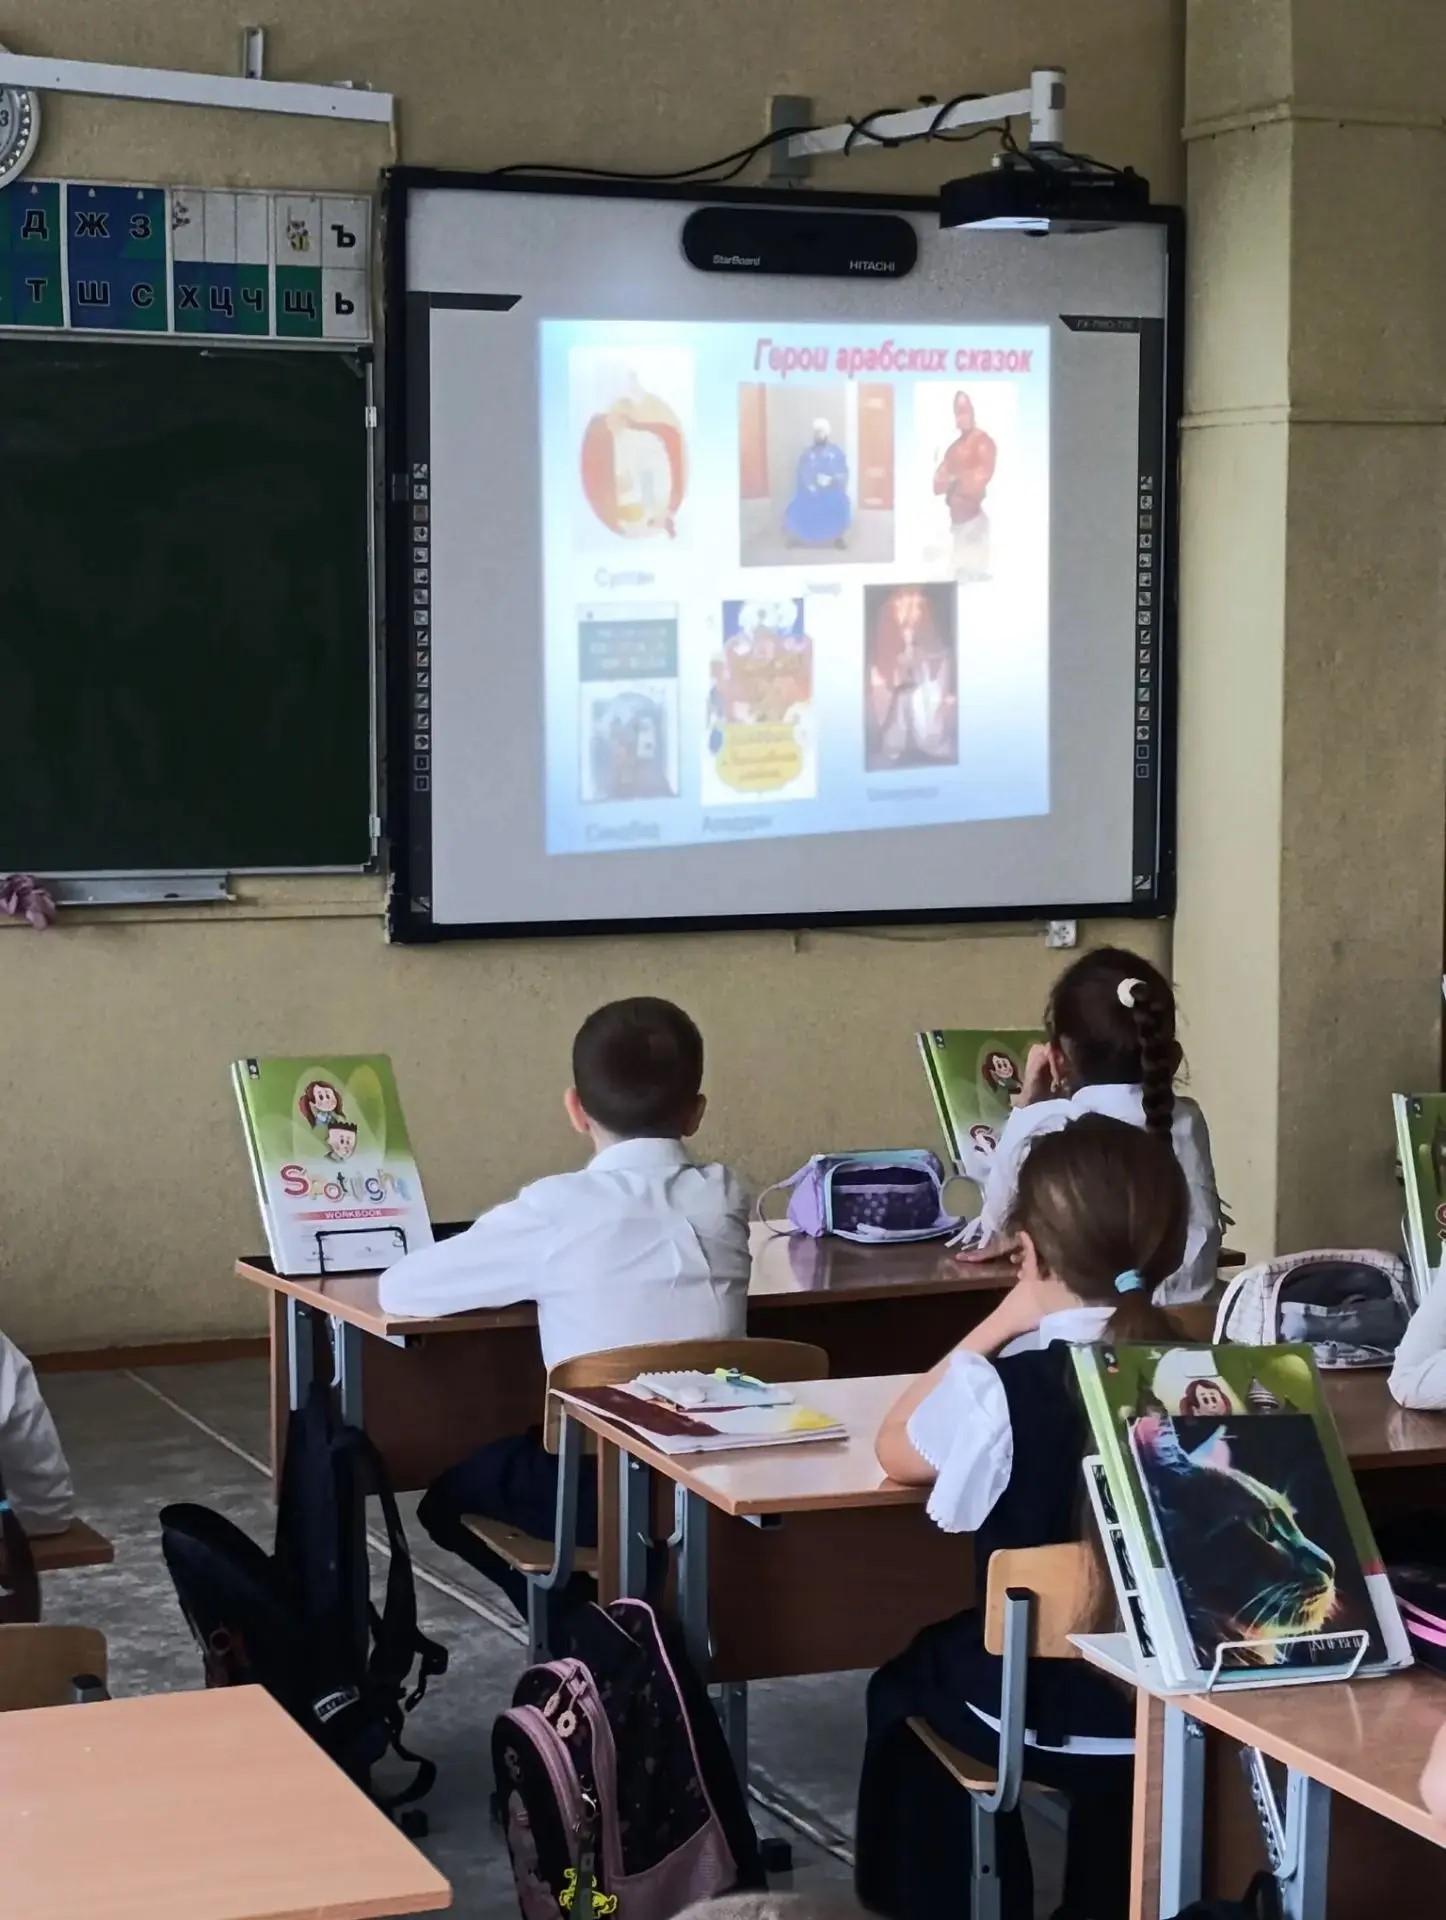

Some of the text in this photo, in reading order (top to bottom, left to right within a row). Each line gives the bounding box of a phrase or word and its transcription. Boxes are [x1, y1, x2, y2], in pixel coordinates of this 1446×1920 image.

[21, 209, 49, 240] Д
[74, 212, 110, 238] Ж
[130, 214, 152, 239] З
[331, 224, 356, 248] Ъ
[713, 254, 760, 266] StarBoard
[850, 260, 895, 272] HITACHI
[25, 278, 48, 303] Т
[77, 281, 111, 306] Ш
[131, 283, 154, 308] С
[179, 284, 200, 309] Х
[209, 286, 234, 317] Ц
[241, 288, 264, 312] Ч
[283, 289, 317, 319] Щ
[335, 292, 355, 315] Ь
[753, 338, 1034, 379] Герои арабских сказок
[325, 1208, 382, 1219] WORKBOOK
